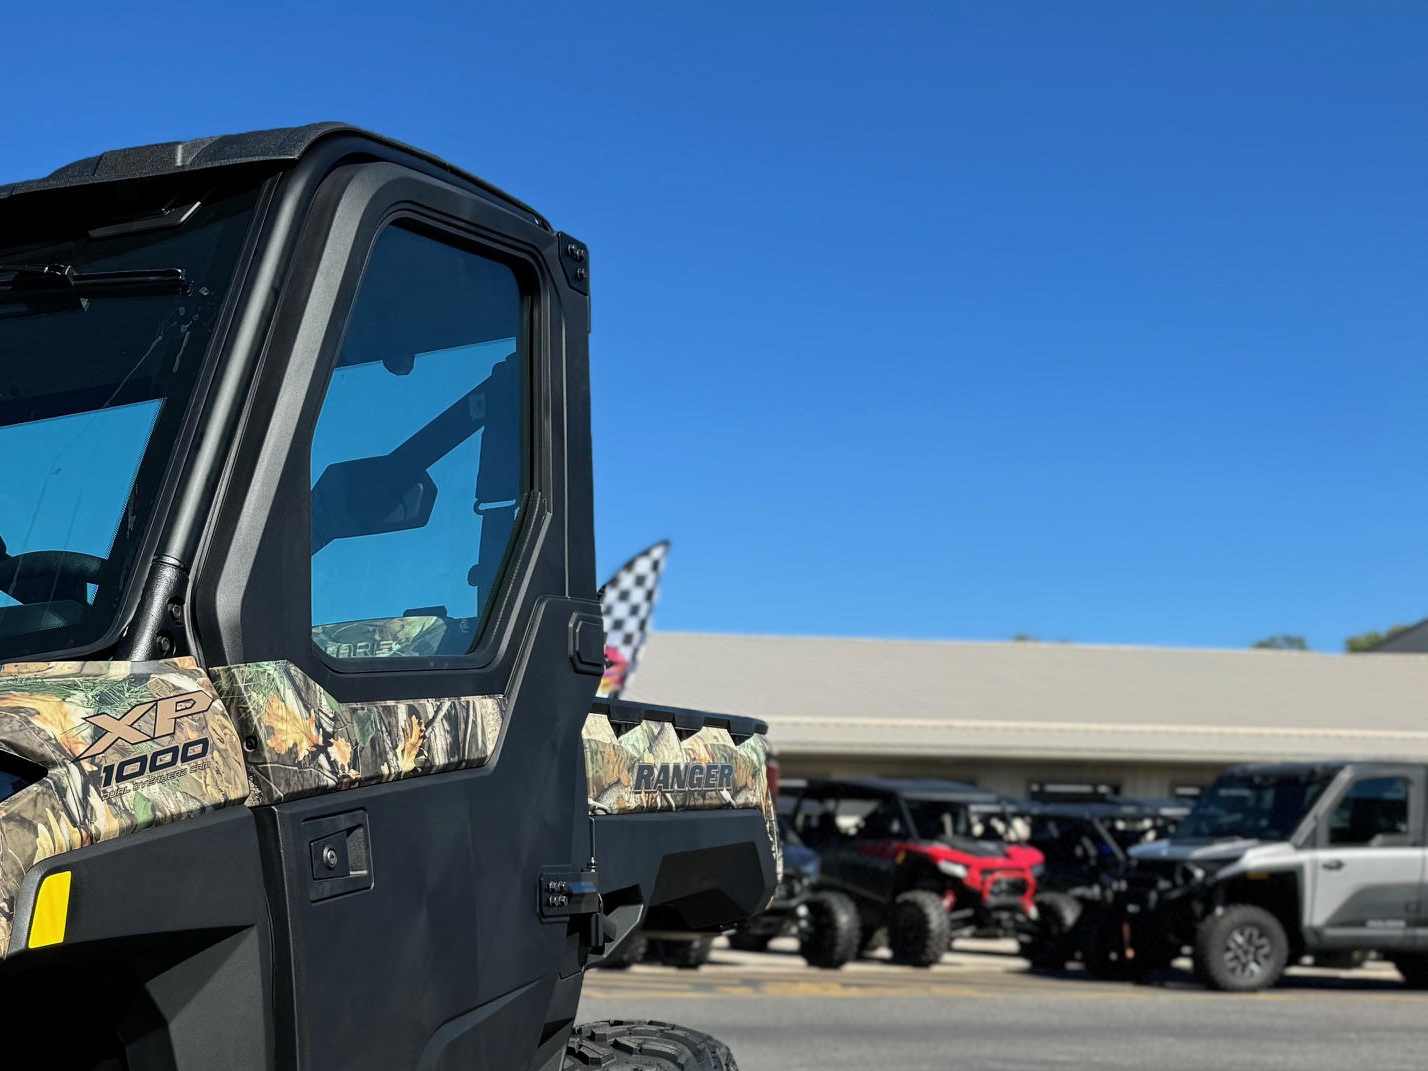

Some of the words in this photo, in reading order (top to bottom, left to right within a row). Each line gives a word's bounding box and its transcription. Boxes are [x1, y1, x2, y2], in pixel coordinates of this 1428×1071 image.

[72, 689, 215, 763] XP
[101, 736, 210, 790] 1000
[633, 762, 735, 793] RANGER
